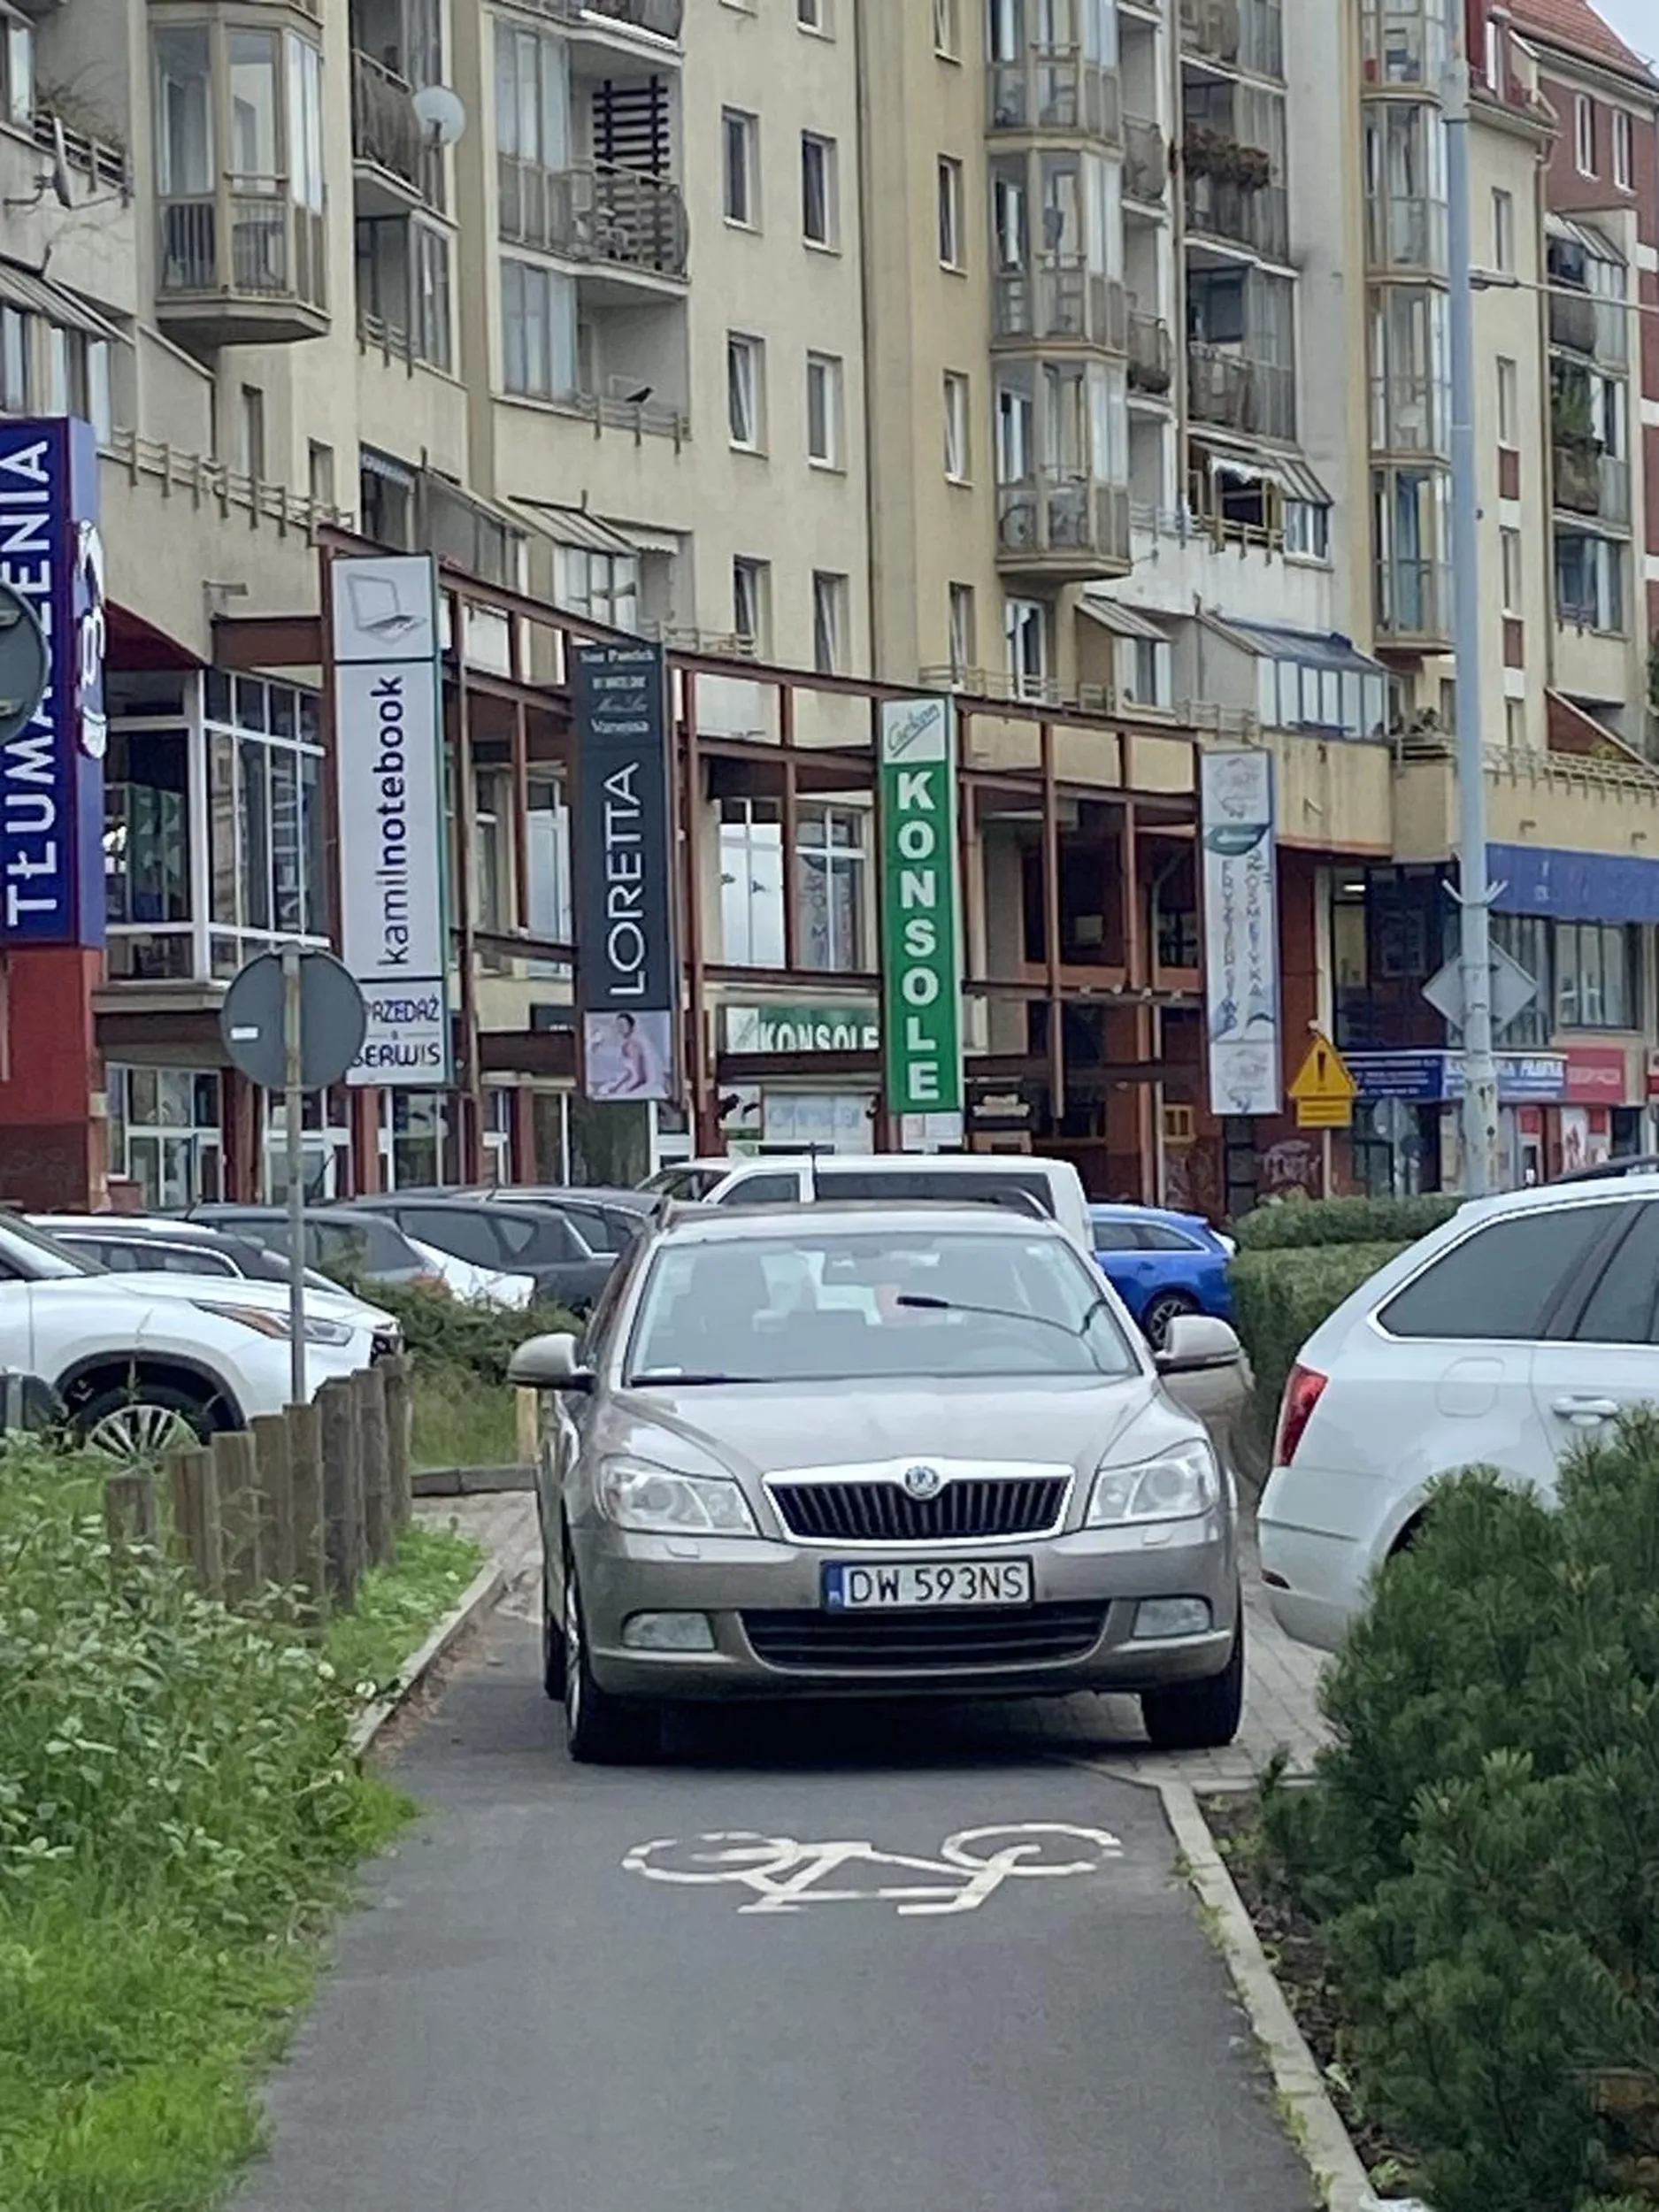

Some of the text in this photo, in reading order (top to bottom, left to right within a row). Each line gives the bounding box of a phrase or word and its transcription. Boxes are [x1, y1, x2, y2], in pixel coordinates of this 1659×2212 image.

[0, 441, 57, 926] TŁUMENIA
[371, 676, 409, 966] kamilnotebook
[603, 762, 646, 995] LORETTA
[897, 772, 940, 1100] KONSOLE
[365, 993, 440, 1023] RZEDAŻ
[849, 1569, 901, 1603] DW
[914, 1565, 1024, 1602] 593NS
